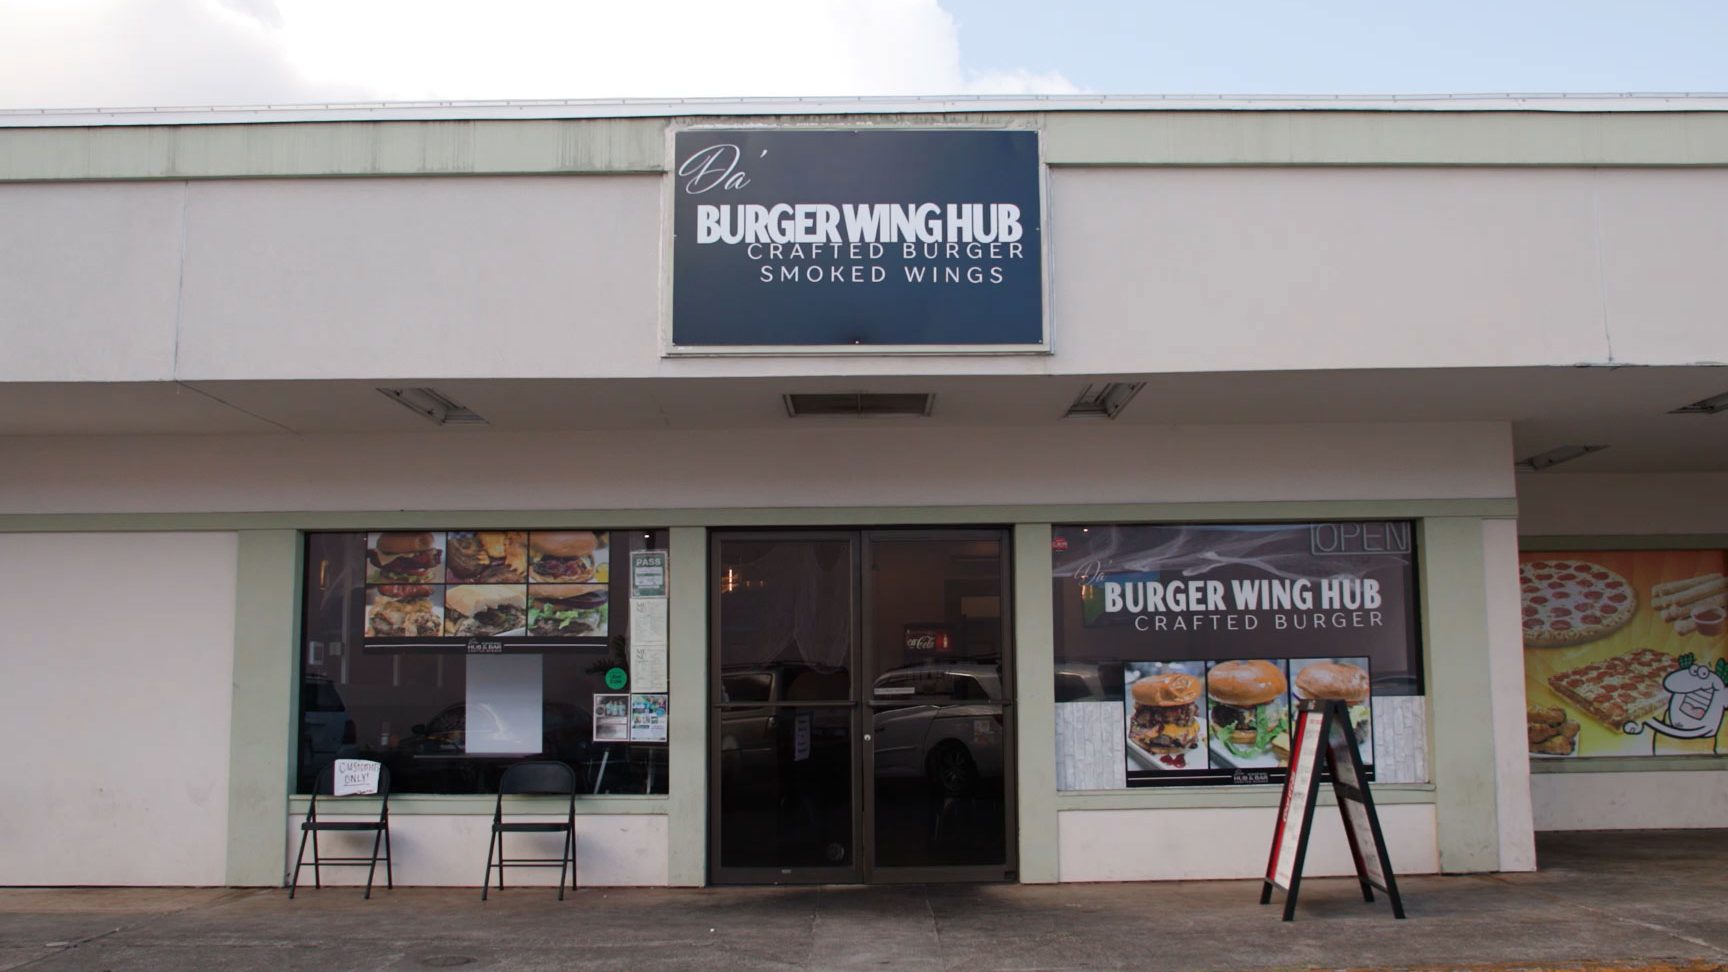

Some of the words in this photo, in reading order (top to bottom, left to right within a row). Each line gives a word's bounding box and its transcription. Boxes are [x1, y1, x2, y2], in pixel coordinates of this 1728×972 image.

[697, 203, 842, 244] BURGER
[843, 203, 943, 244] WING
[947, 203, 1023, 244] HUB
[747, 243, 883, 259] CRAFTED
[903, 242, 1023, 259] BURGER
[760, 265, 885, 283] SMOKED
[905, 266, 1003, 284] WINGS
[1316, 522, 1407, 552] OPEN
[636, 558, 661, 566] PASS
[1105, 580, 1227, 613] BURGER
[1231, 578, 1313, 611] WING
[1321, 578, 1381, 610] HUB
[1135, 615, 1257, 631] CRAFTED
[1276, 612, 1383, 629] BURGER
